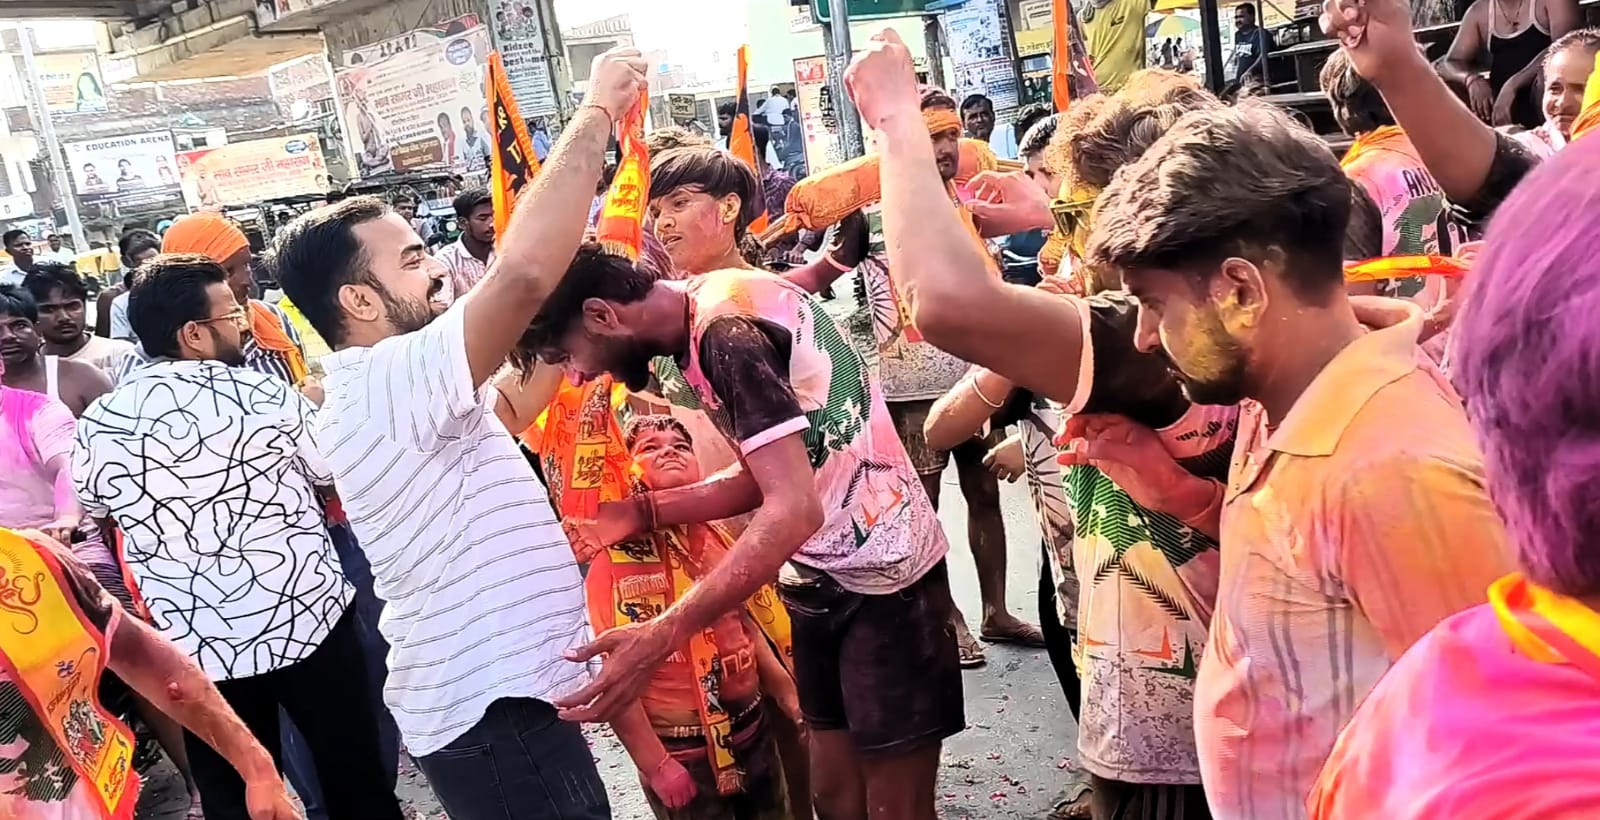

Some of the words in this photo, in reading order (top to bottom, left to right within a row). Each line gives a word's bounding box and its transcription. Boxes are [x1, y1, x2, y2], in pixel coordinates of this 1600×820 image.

[503, 56, 524, 67] best
[86, 139, 137, 151] EDUCATION
[140, 135, 170, 144] ARENA
